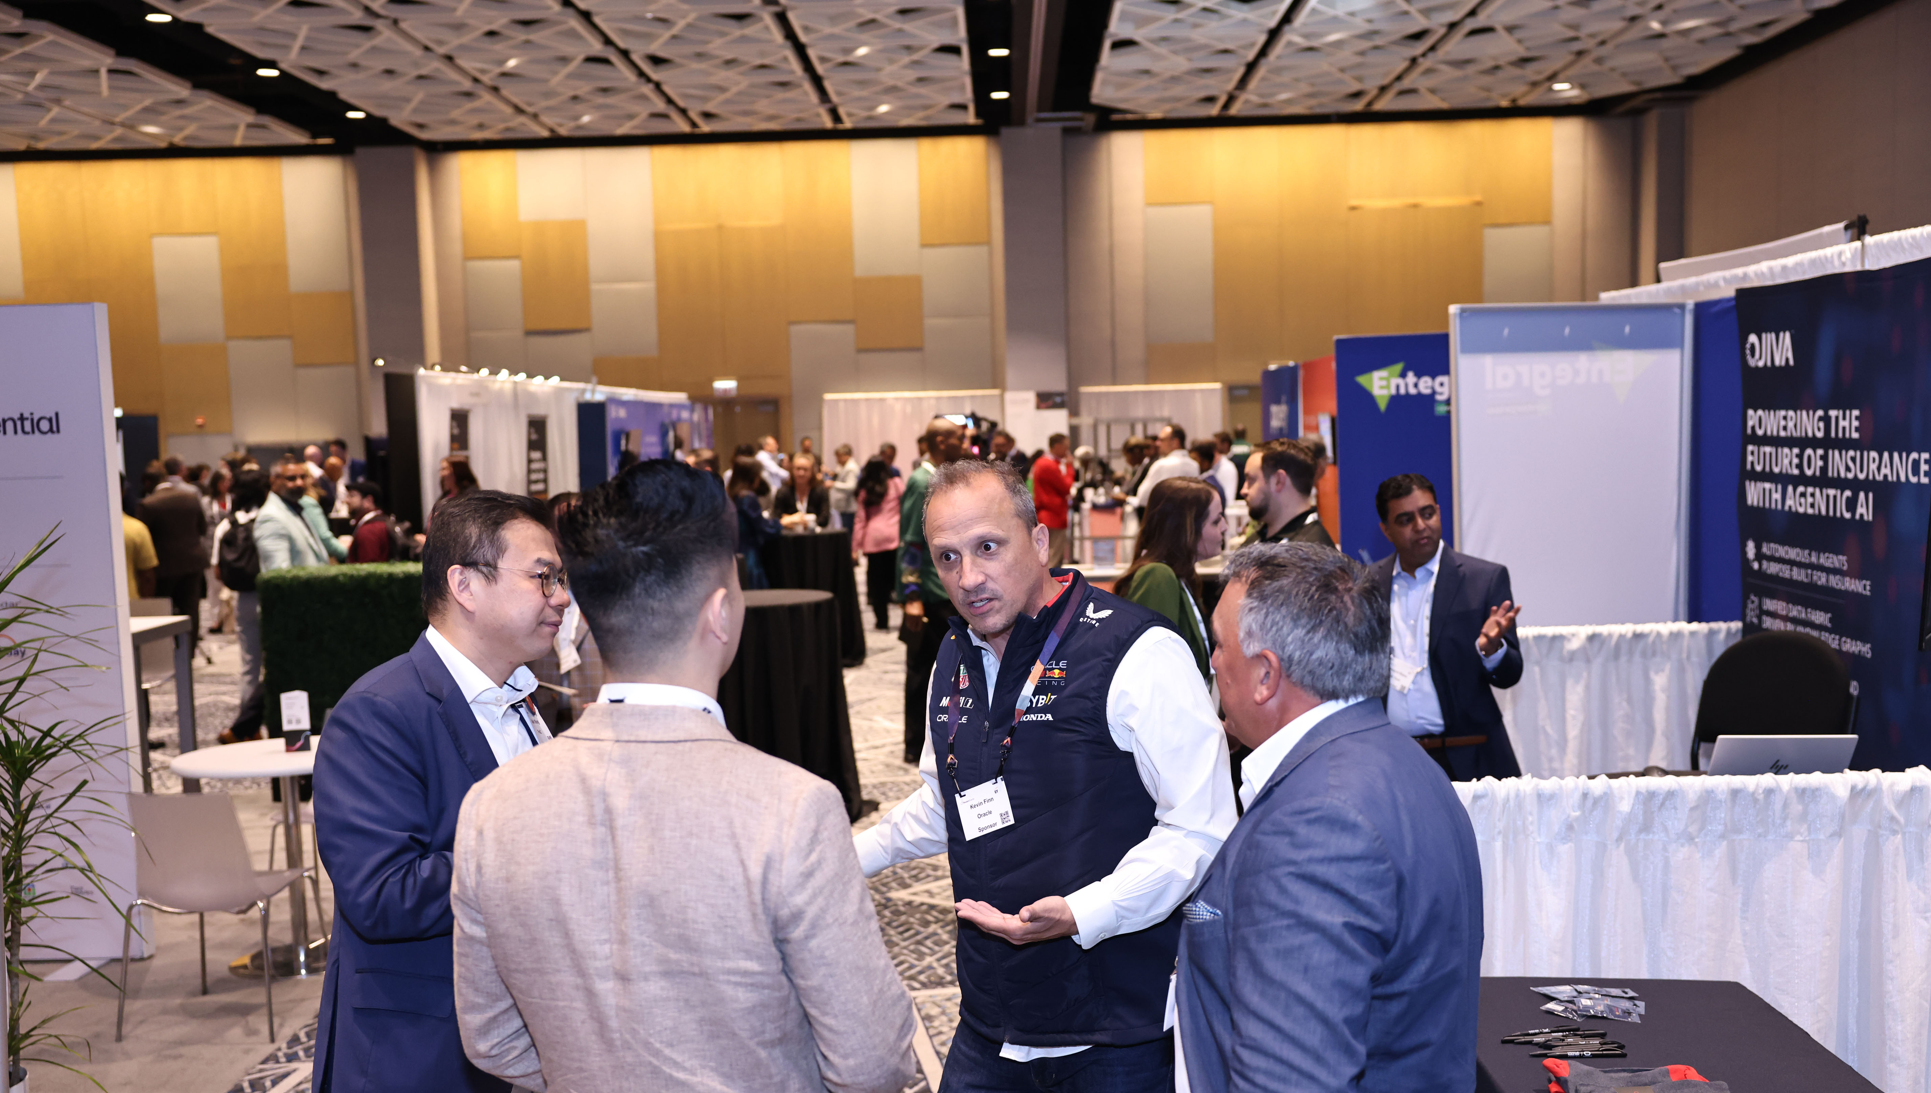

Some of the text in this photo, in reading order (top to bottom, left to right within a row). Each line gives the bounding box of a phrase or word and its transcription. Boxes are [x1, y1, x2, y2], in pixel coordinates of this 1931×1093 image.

[0, 411, 61, 436] ntial
[1746, 408, 1860, 439] POWERING THE
[1746, 444, 1931, 484] FUTURE OF INSURANCE
[1745, 480, 1874, 521] WITH AGENTIC AI
[1761, 541, 1849, 571] AUTONOMOUS AI AGENTS
[1812, 569, 1828, 586] FOR
[1828, 573, 1872, 596] INSURANCE
[1761, 596, 1833, 628] UNIFIED DATA FABRIC
[1840, 636, 1873, 659] GRAPHS
[969, 800, 984, 811] Kevin
[976, 809, 993, 820] Oracle
[977, 821, 998, 833] Sponsor
